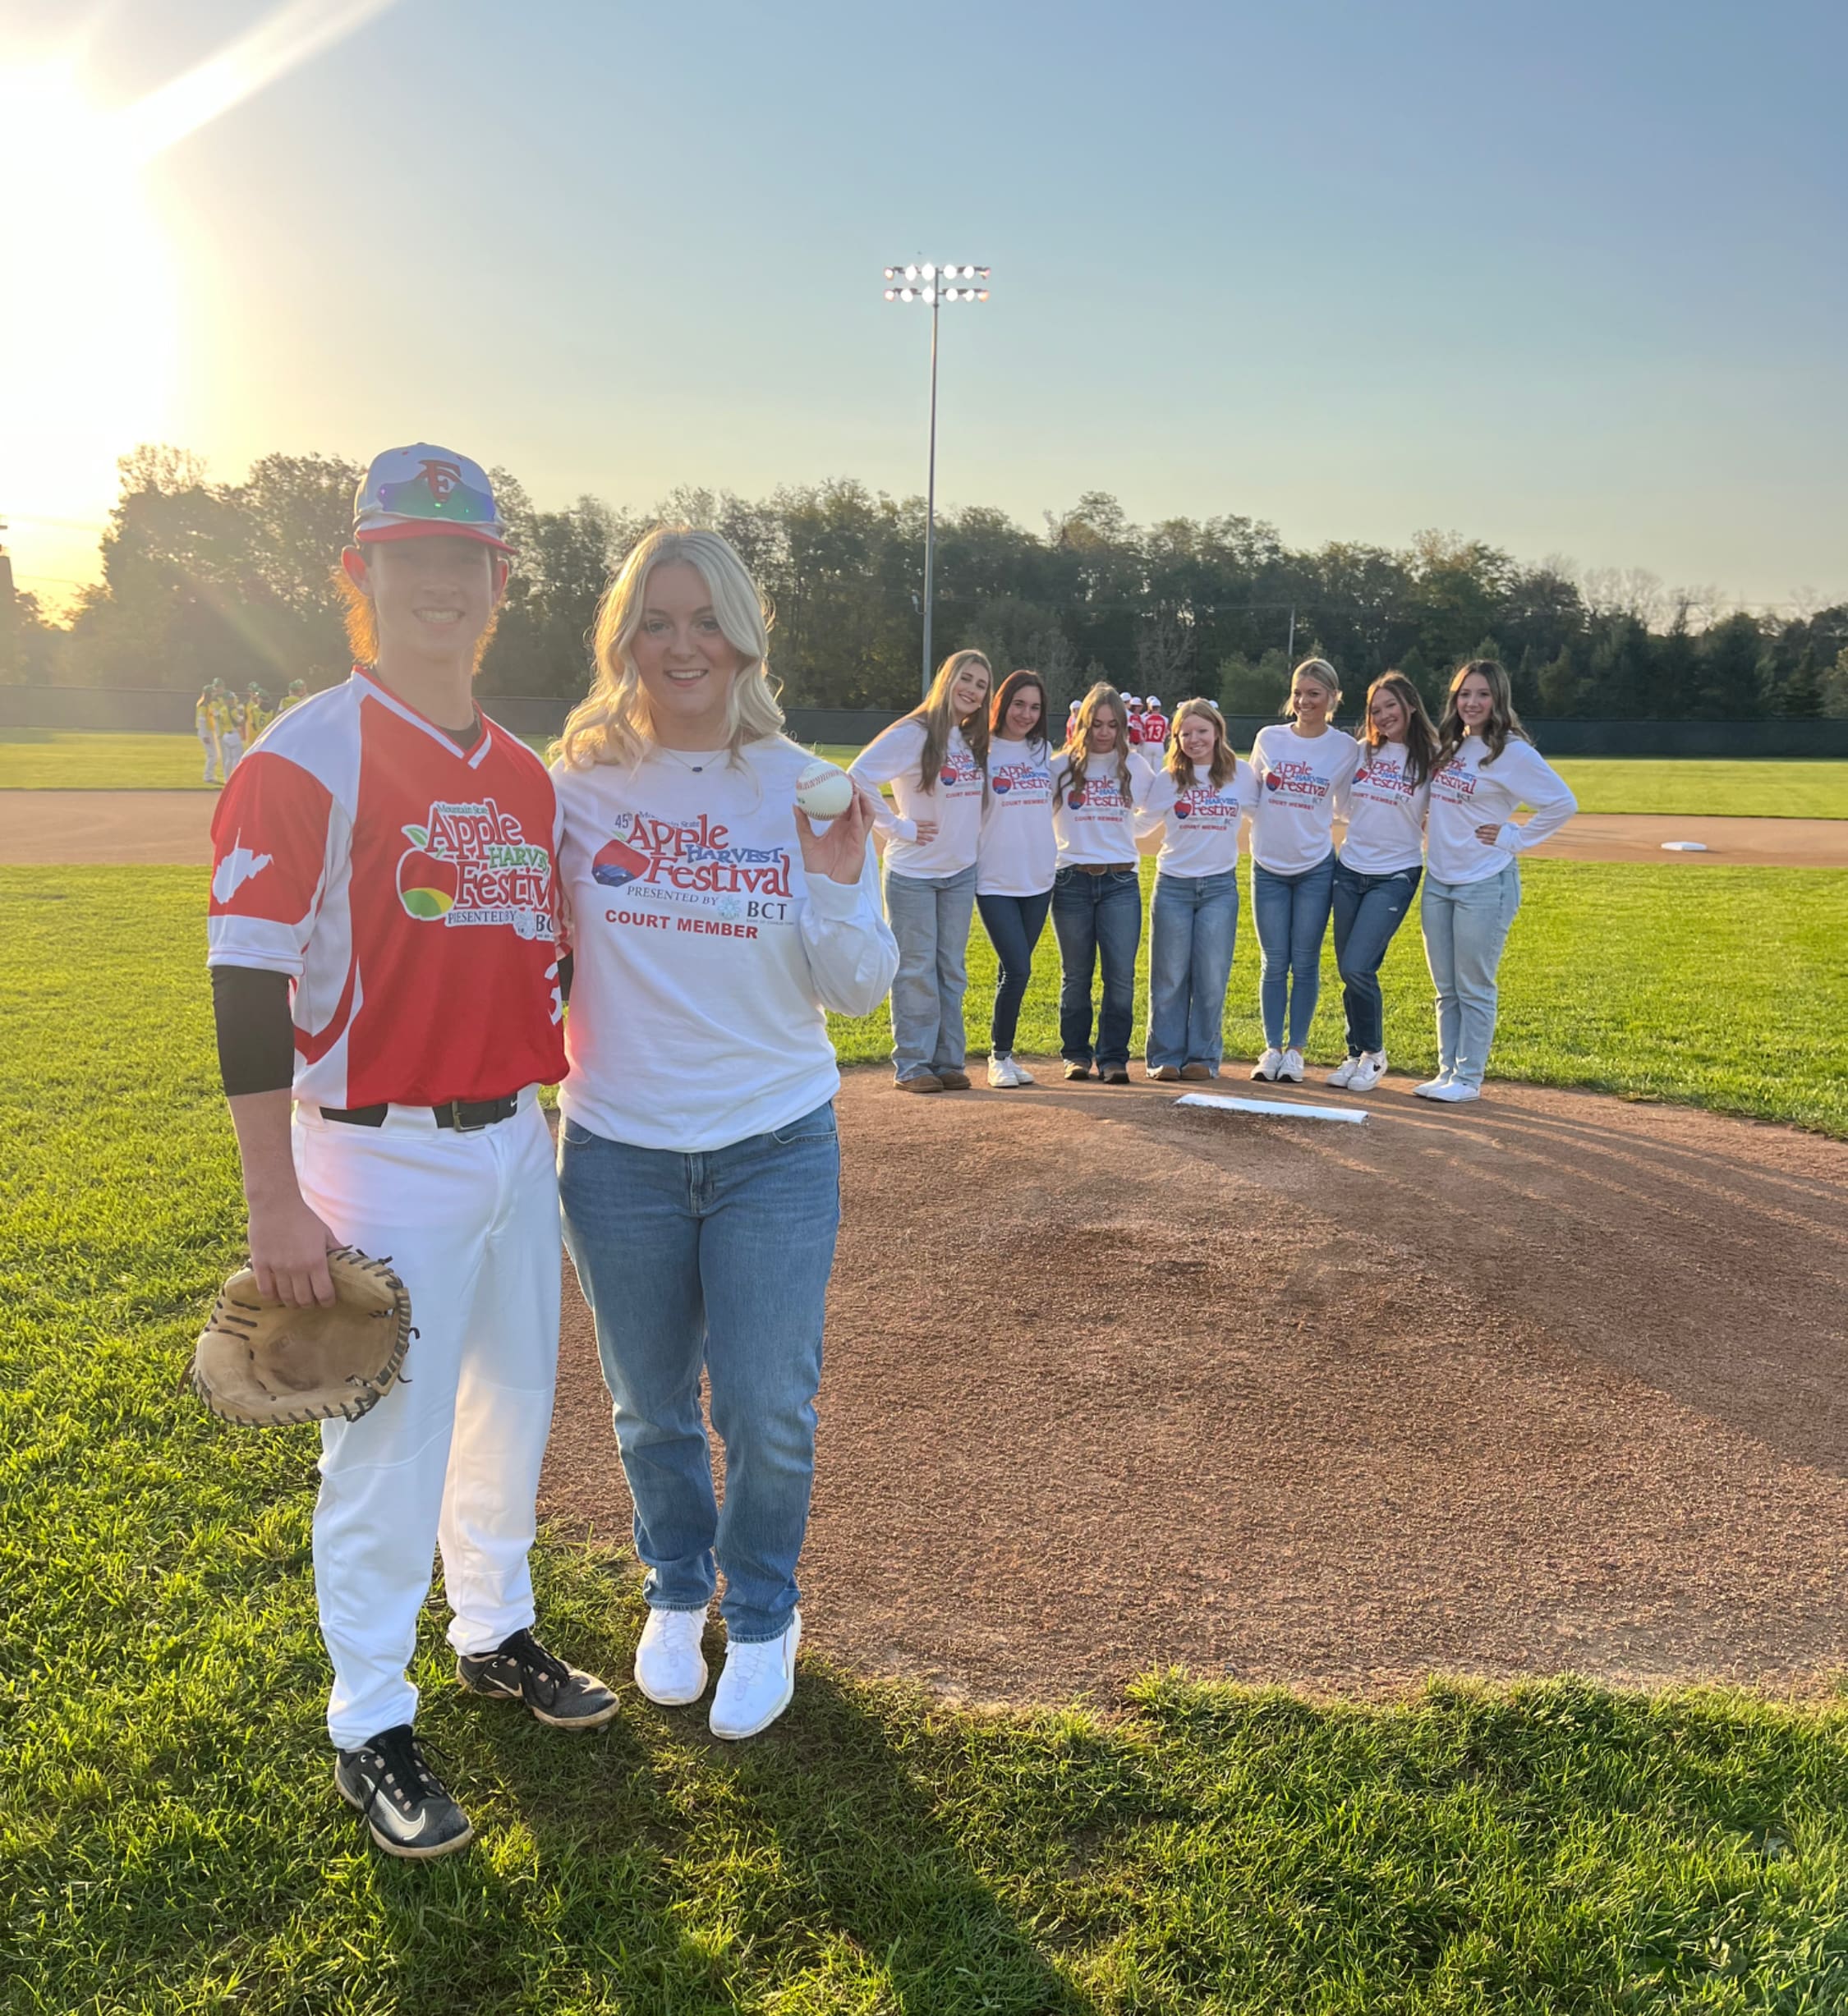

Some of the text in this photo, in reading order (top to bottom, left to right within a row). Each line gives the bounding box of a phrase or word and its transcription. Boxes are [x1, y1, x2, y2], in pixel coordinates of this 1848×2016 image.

[1147, 725, 1163, 739] 13
[999, 762, 1032, 780] Apple
[1274, 761, 1312, 778] Apple
[1182, 785, 1221, 802] Apple
[1280, 776, 1330, 797] Festival
[1191, 801, 1239, 817] Festival
[425, 801, 522, 860] Apple
[626, 814, 729, 856] Apple
[685, 844, 784, 863] HARVEST
[644, 855, 793, 898] Festival
[627, 885, 719, 906] PRESENTED BY
[747, 901, 788, 921] BCT
[605, 909, 758, 939] COURT MEMBER
